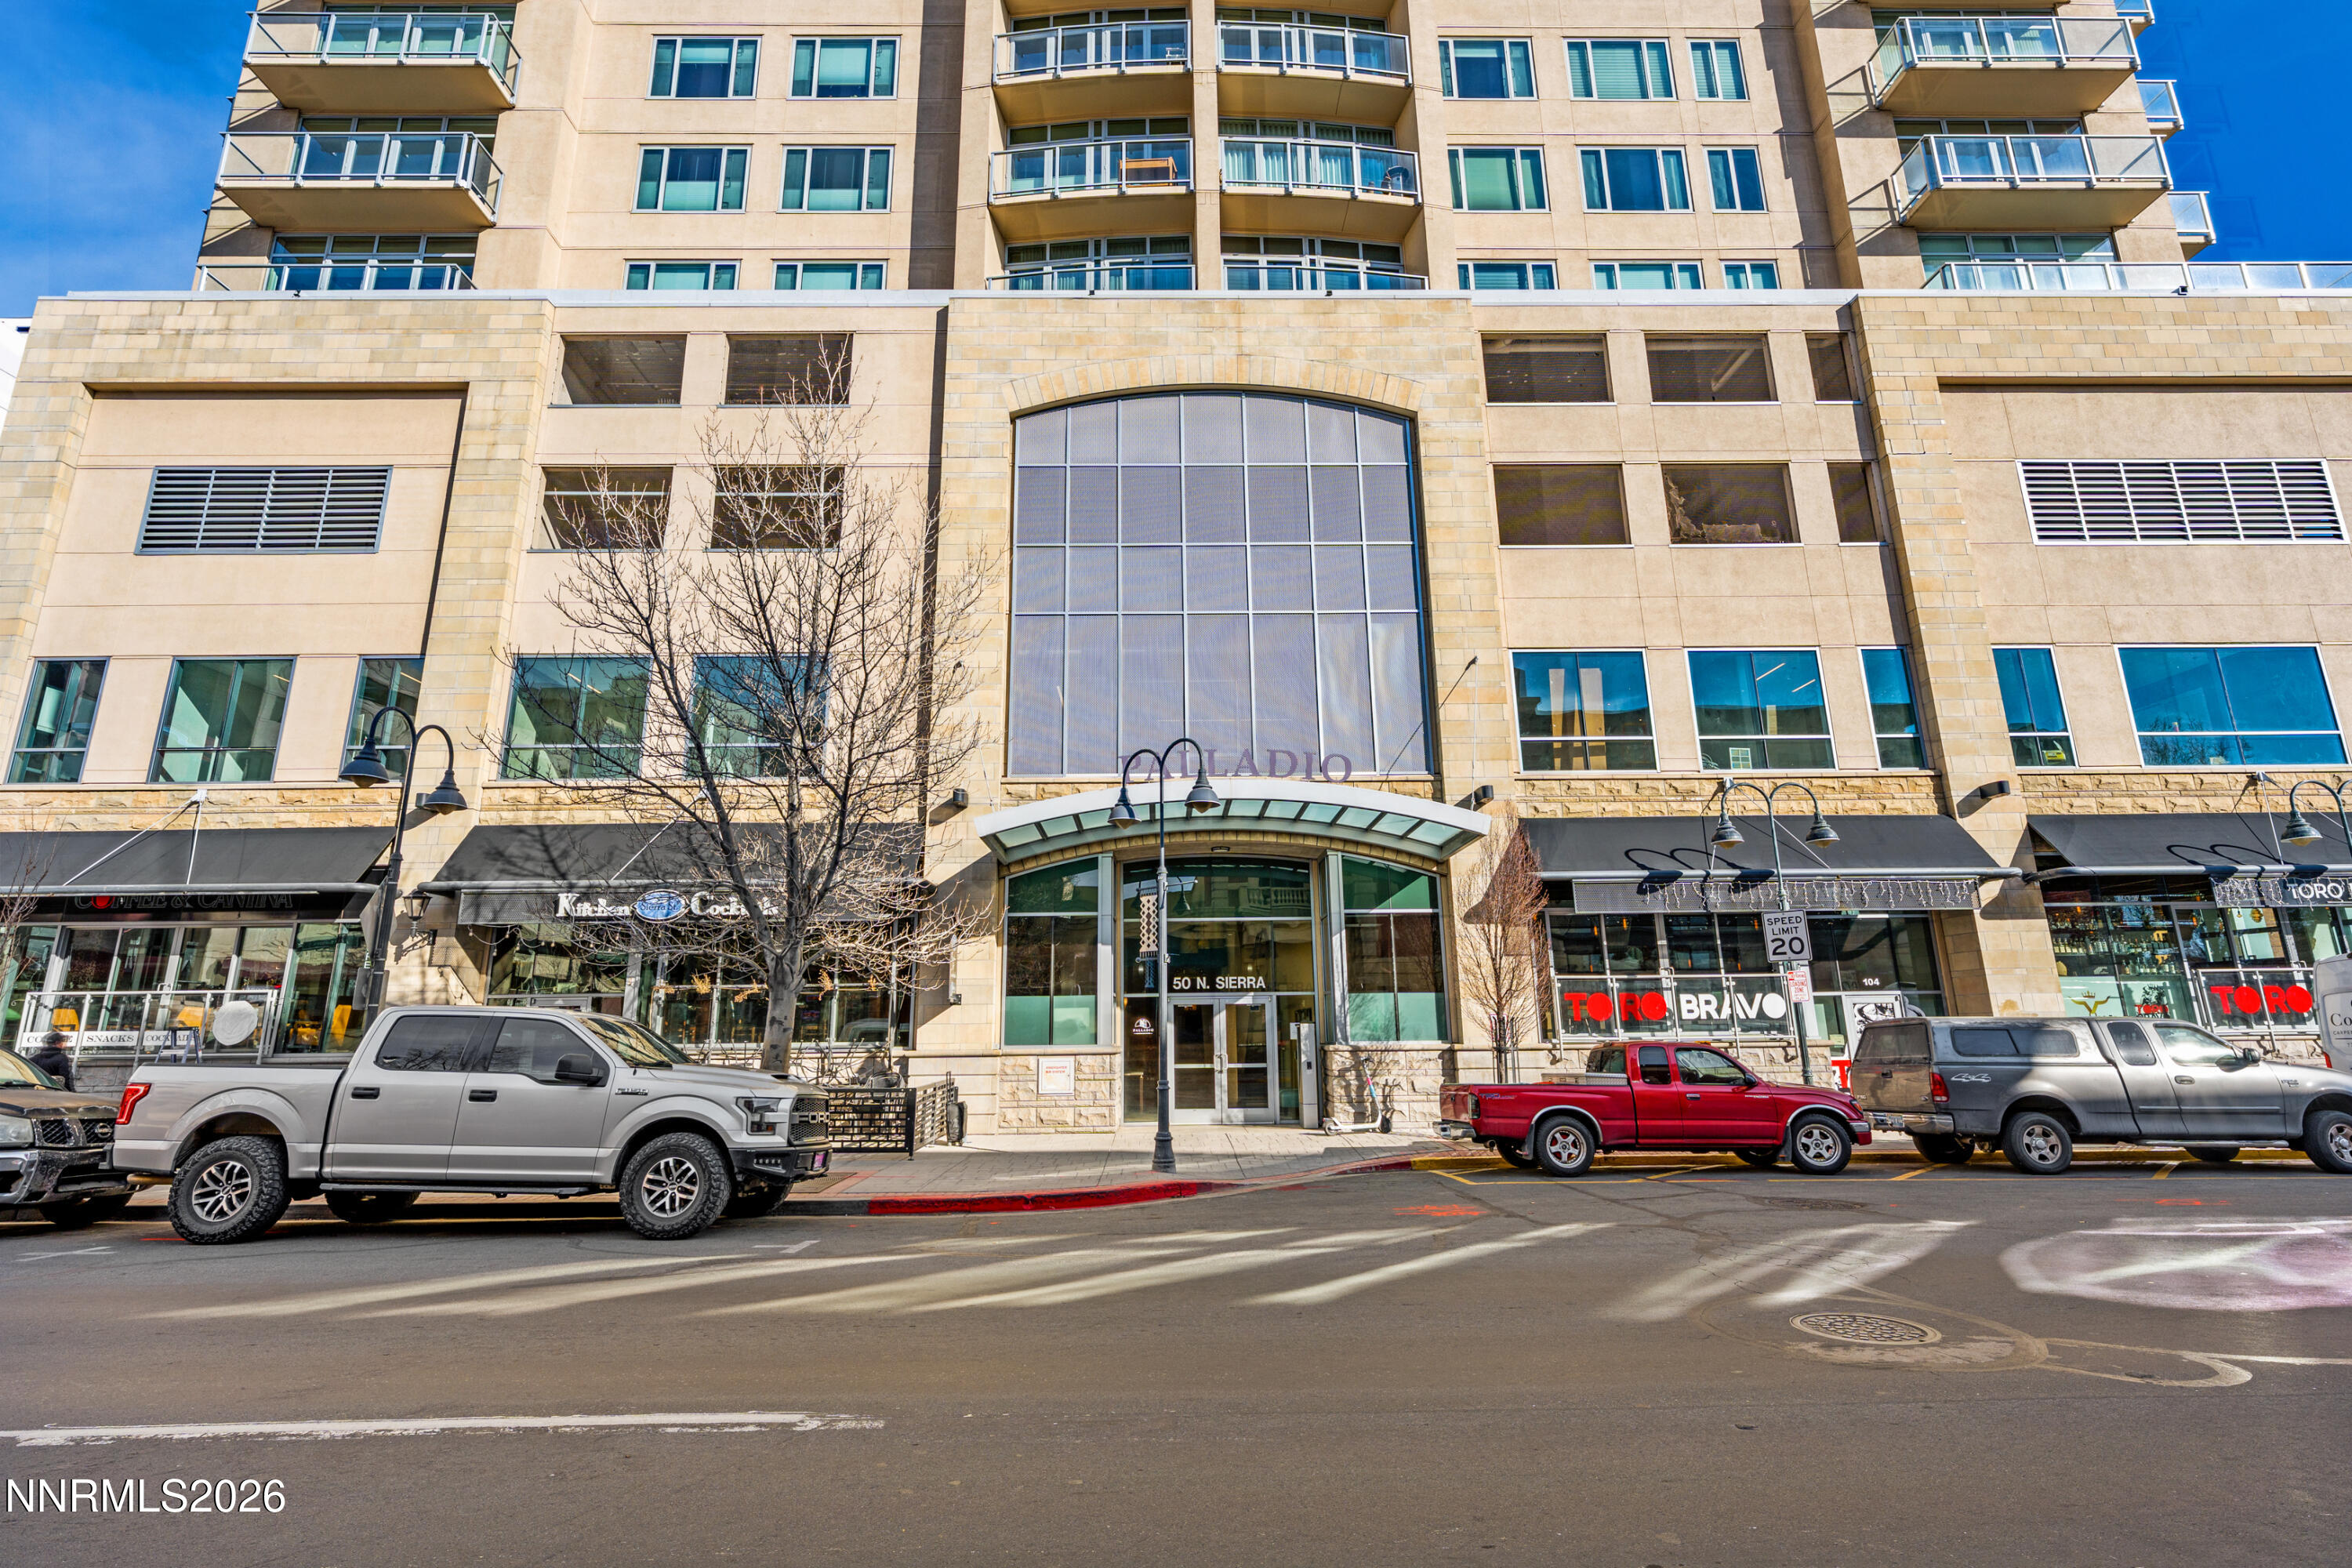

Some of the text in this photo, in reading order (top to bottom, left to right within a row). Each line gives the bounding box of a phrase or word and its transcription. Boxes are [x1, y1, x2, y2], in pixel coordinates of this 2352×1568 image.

[1118, 748, 1352, 783] PALLADIO
[2287, 883, 2343, 898] TORO
[555, 892, 632, 917] Kitchen
[640, 902, 678, 912] Sierra St.
[1767, 916, 1802, 925] SPEED
[1772, 926, 1799, 935] LIMIT
[1770, 936, 1805, 956] 20
[1172, 975, 1266, 990] 50 N. SIERRA
[1862, 977, 1880, 986] 104
[1563, 991, 1787, 1022] TORO BRAVO
[2210, 985, 2313, 1014] TORO
[2330, 1012, 2352, 1026] Co
[86, 1034, 135, 1044] SNACKS
